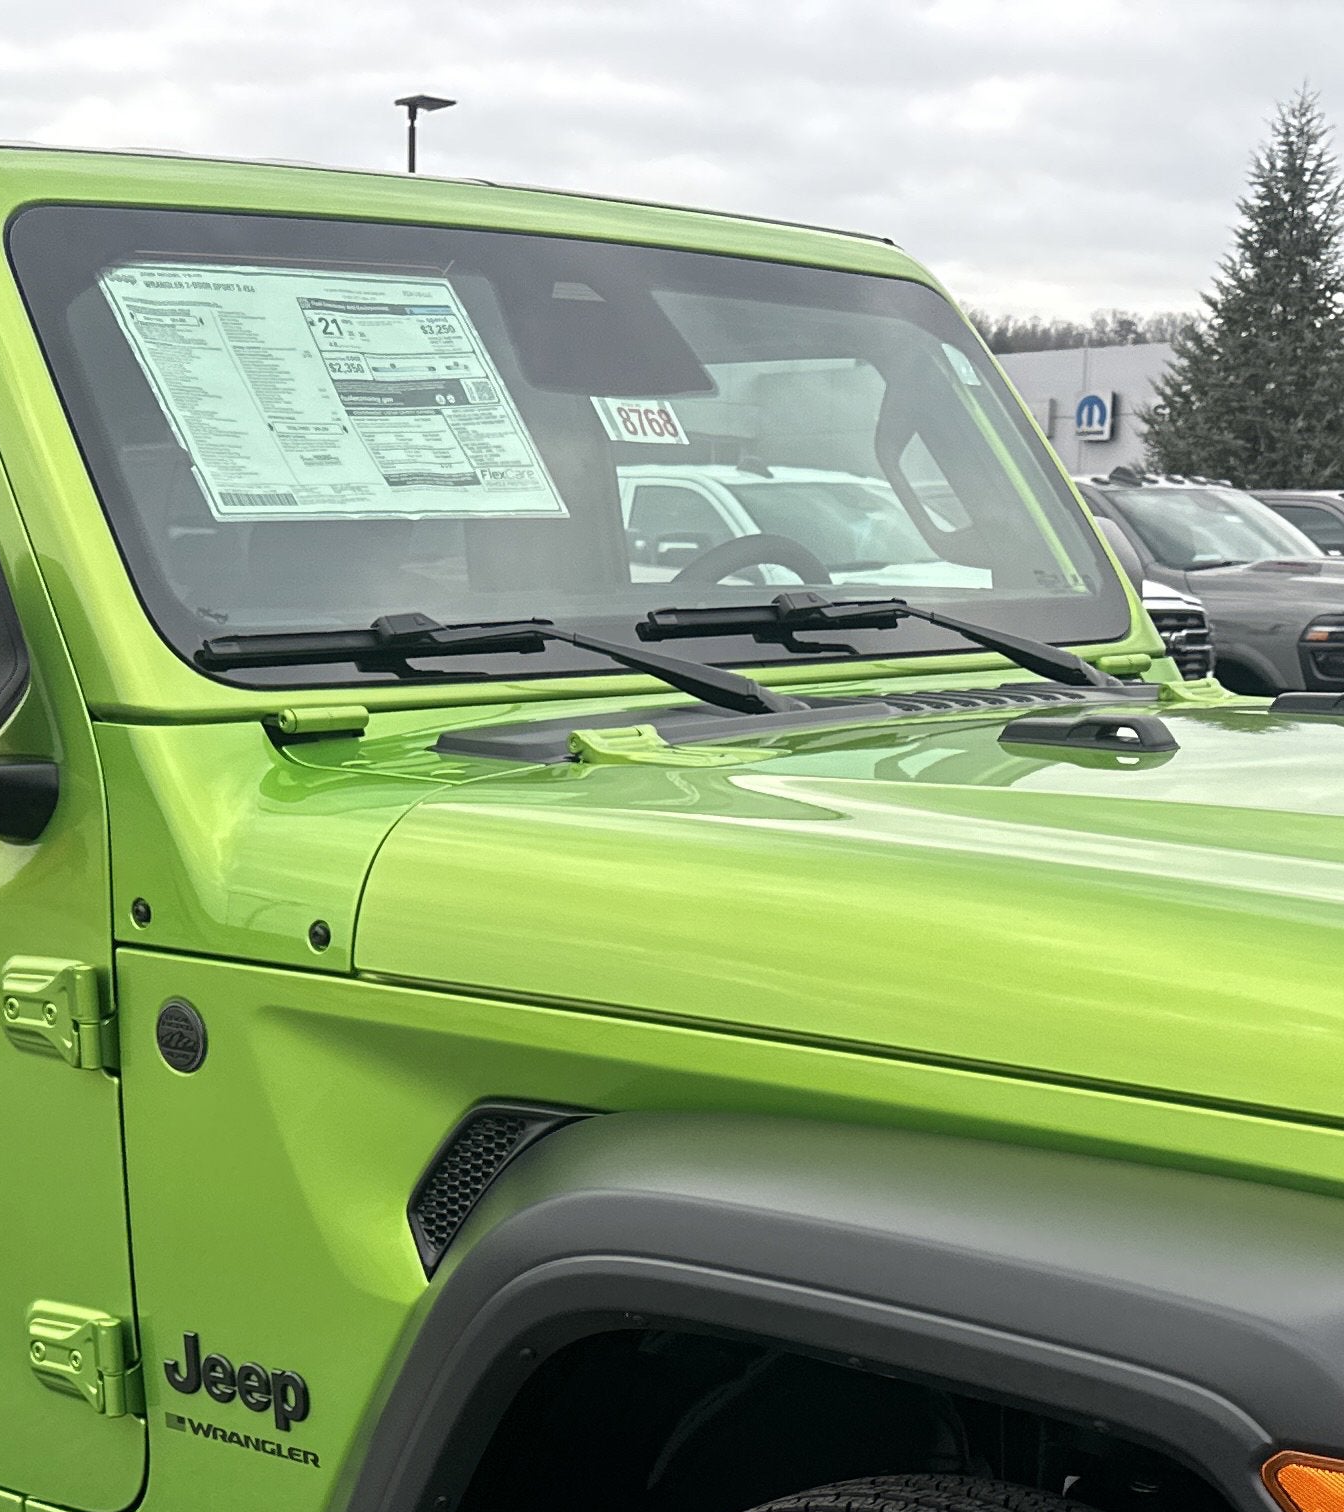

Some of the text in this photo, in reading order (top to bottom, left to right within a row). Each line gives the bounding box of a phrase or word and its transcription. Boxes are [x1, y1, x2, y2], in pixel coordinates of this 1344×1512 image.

[318, 317, 343, 336] 21
[617, 407, 679, 438] 8768
[480, 468, 535, 480] FlexCare
[164, 1330, 310, 1433] Jeep
[187, 1417, 321, 1468] WRANGLER
